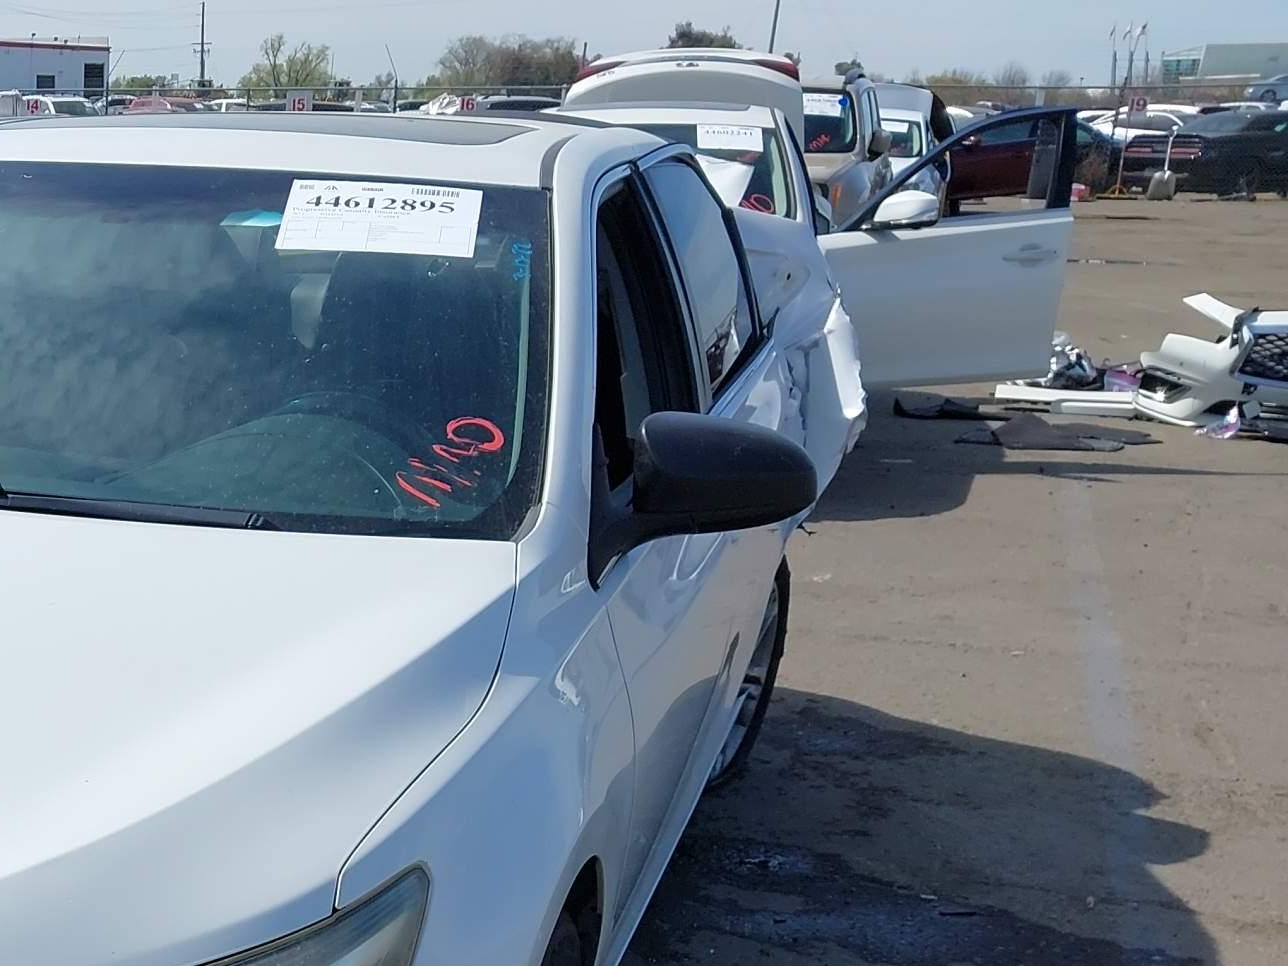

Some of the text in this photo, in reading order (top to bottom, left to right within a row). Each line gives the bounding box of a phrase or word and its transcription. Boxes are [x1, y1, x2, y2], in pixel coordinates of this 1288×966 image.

[27, 100, 39, 112] 14
[293, 98, 305, 111] 15
[462, 99, 475, 111] 16
[1129, 97, 1146, 112] 19
[306, 195, 455, 214] 44612895
